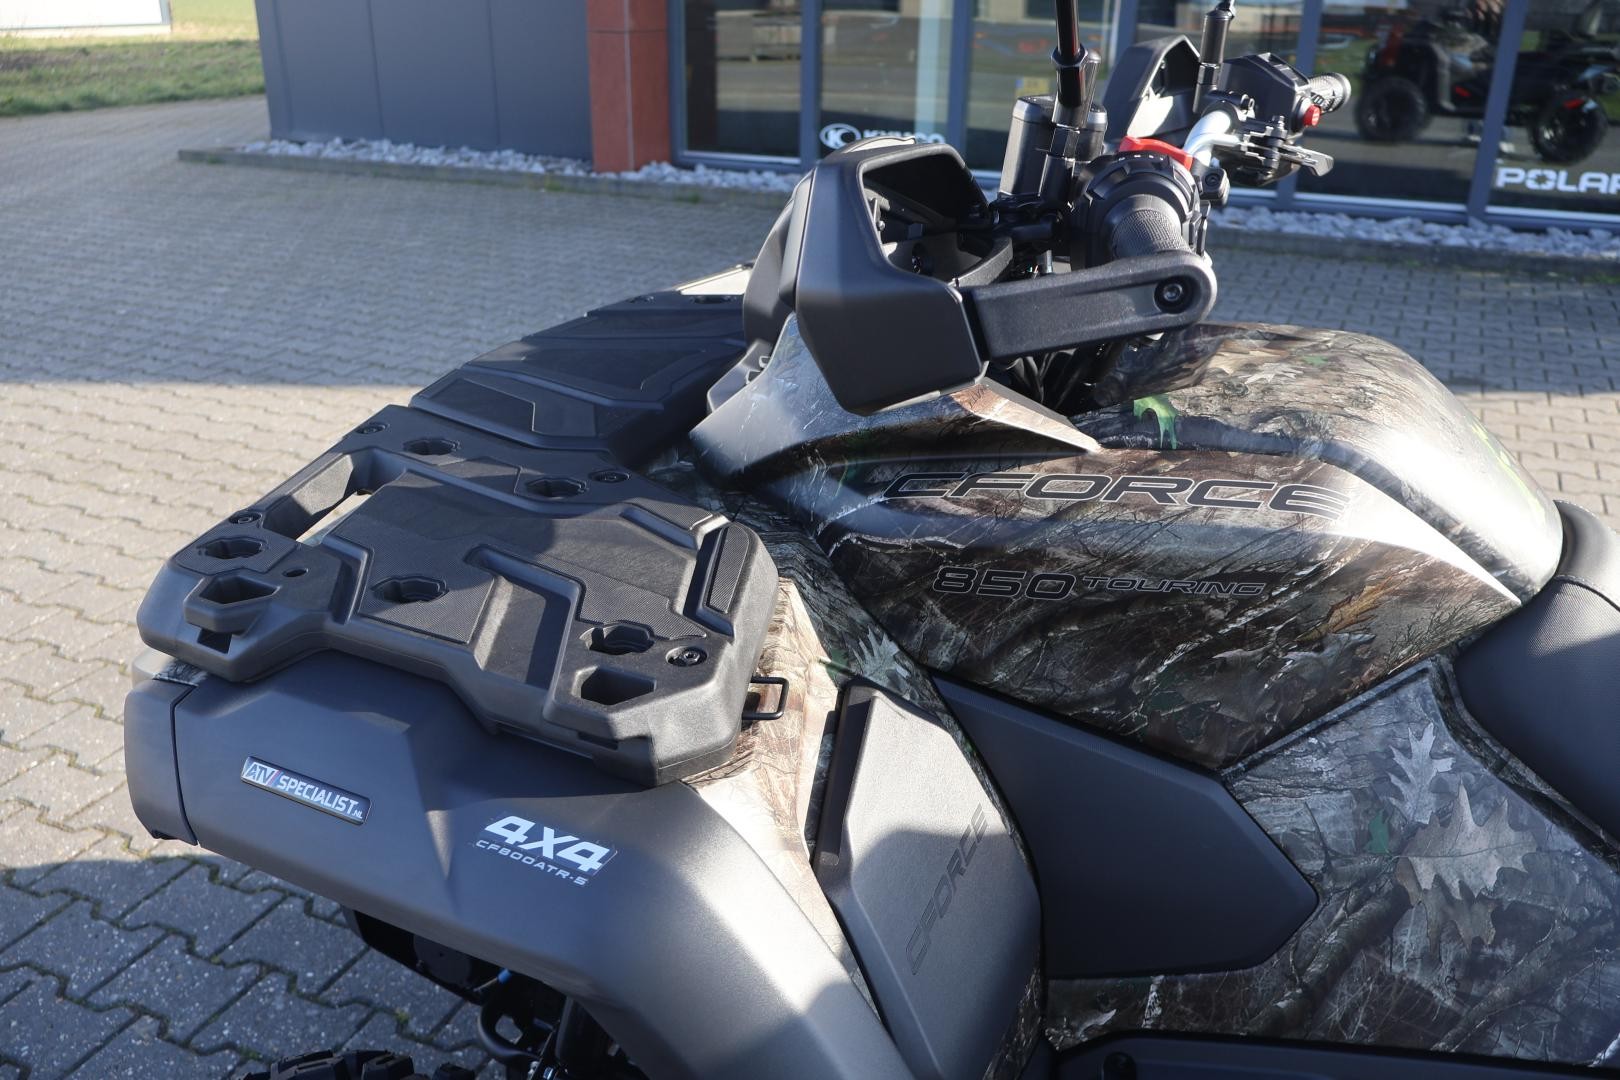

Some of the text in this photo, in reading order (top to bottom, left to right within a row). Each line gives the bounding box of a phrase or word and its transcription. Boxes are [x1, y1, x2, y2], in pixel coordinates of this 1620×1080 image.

[882, 471, 1350, 521] CFORCE
[932, 566, 1267, 600] 850 TOURING
[246, 763, 277, 785] ATV
[484, 815, 610, 872] 4X4
[905, 802, 988, 976] CFORCE
